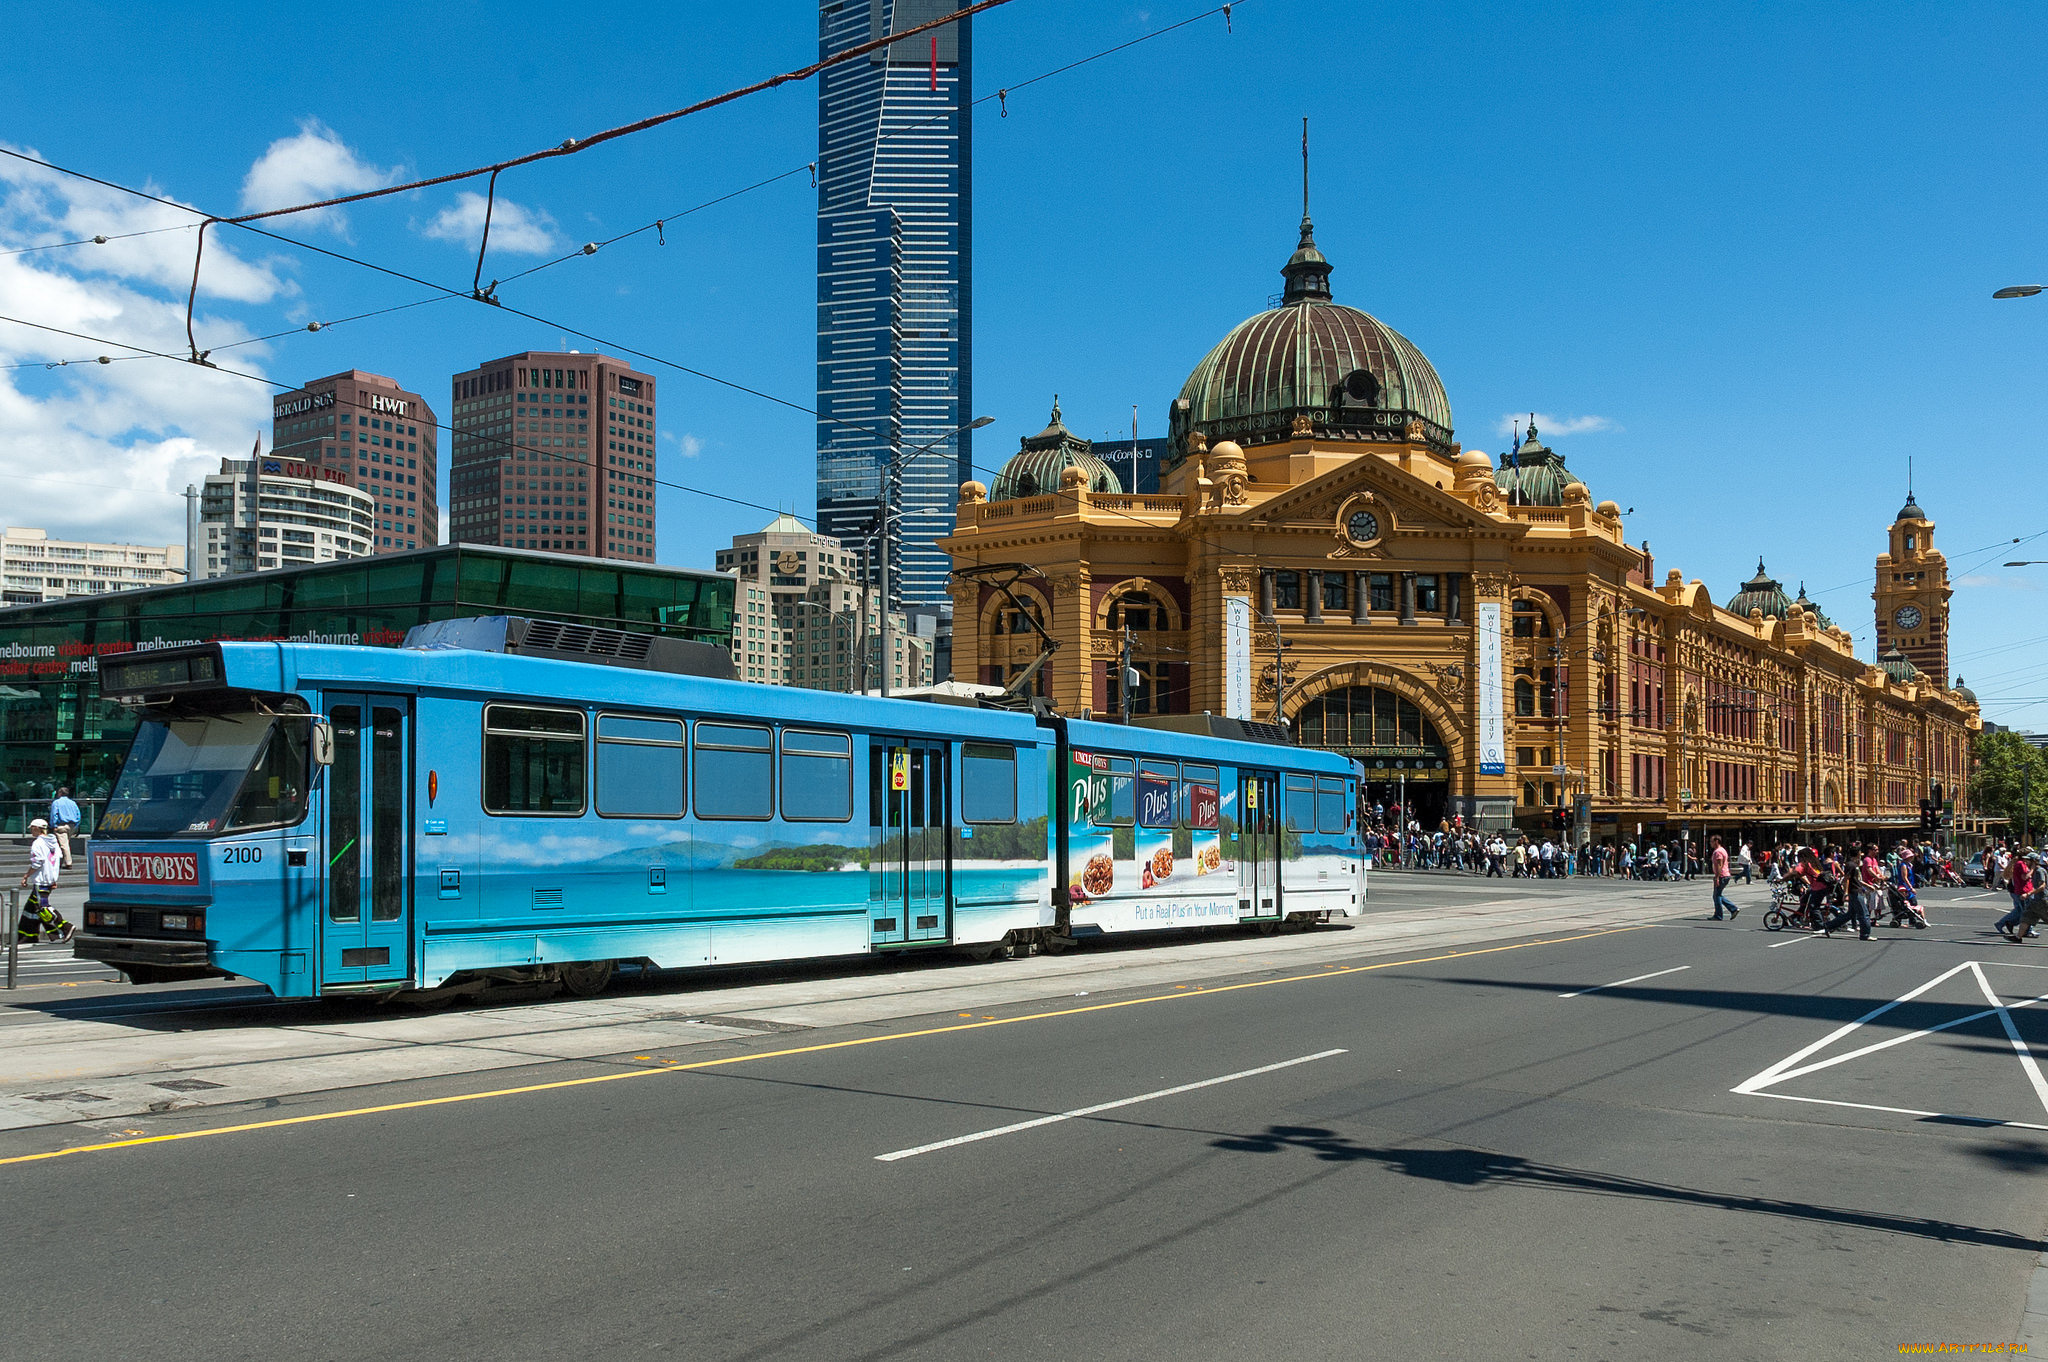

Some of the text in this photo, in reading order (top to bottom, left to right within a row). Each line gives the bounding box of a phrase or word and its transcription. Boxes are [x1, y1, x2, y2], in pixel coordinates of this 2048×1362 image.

[274, 391, 334, 418] HERALD SUN
[371, 394, 407, 415] HWT
[286, 462, 346, 485] QUAY WEST
[810, 533, 841, 548] Langham
[1234, 608, 1242, 646] world
[1487, 614, 1495, 651] world
[58, 640, 95, 657] visitor
[33, 660, 67, 675] centre
[1075, 750, 1107, 769] UNCLE OBYS
[1072, 775, 1107, 824] Plus
[1143, 789, 1167, 825] Plus
[98, 813, 133, 831] 2100
[1197, 799, 1216, 827] Plus
[223, 847, 262, 864] 2100
[96, 855, 195, 881] UNCLE TOBYS
[1135, 905, 1148, 920] Put
[1149, 907, 1153, 919] a
[1156, 904, 1170, 919] Real
[1172, 903, 1185, 918] Plus
[1193, 903, 1208, 917] Your
[1208, 902, 1233, 918] Morning
